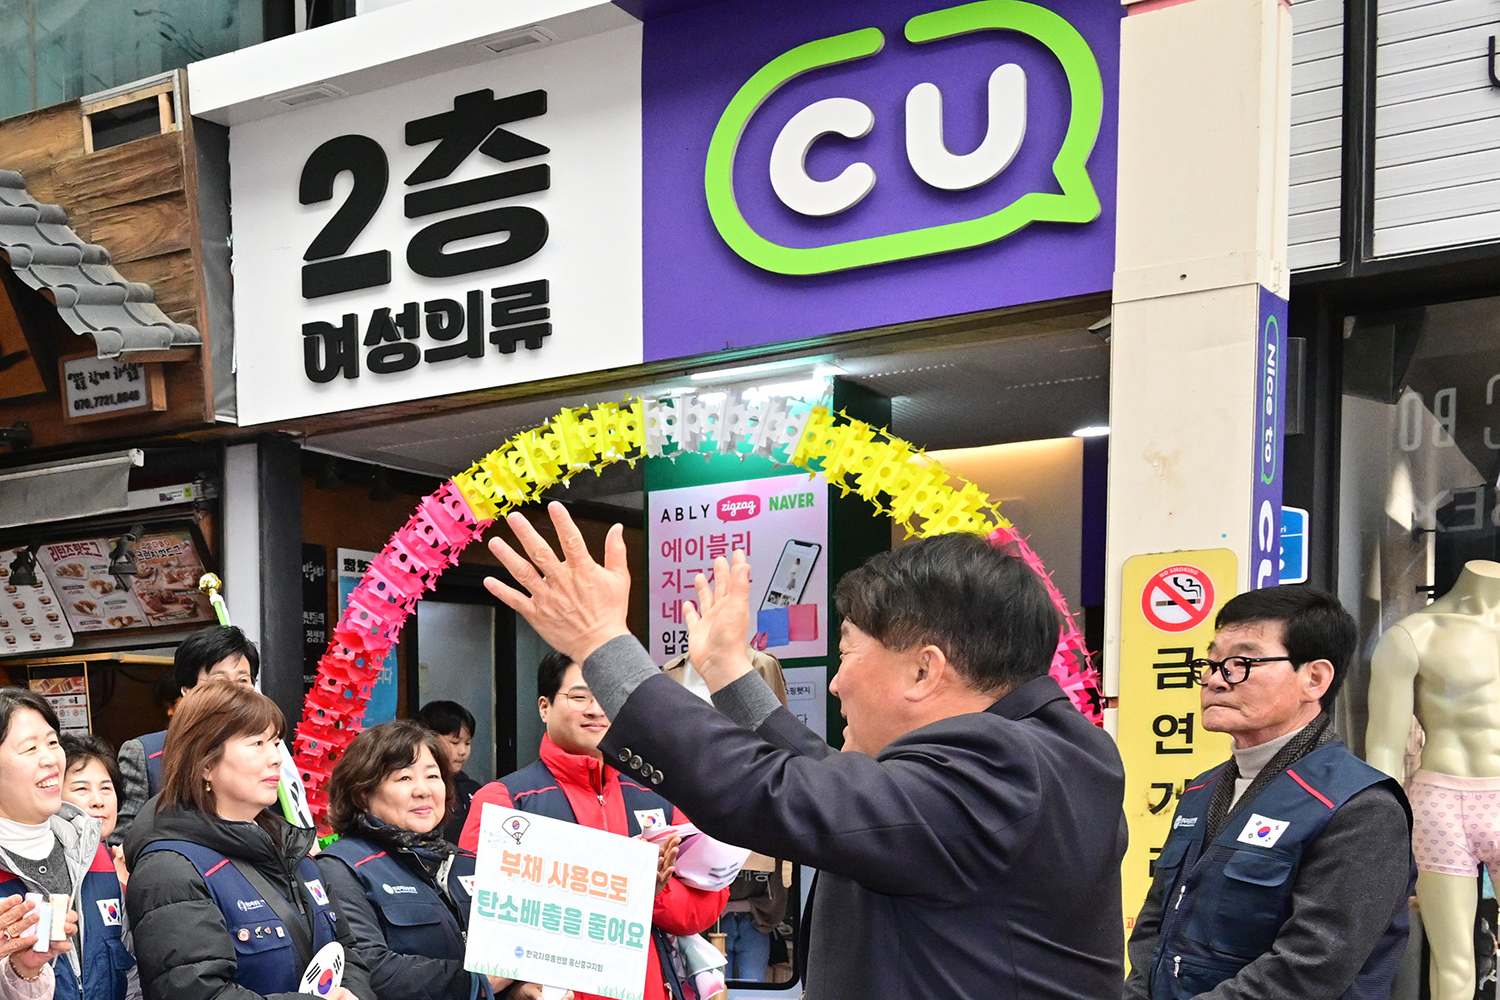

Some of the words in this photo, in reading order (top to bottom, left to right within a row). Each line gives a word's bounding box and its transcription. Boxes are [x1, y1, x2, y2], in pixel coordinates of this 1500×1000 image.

[768, 62, 1028, 217] CU
[299, 89, 552, 299] 2층
[301, 279, 553, 384] 여성의류
[1266, 343, 1277, 416] Nice
[1264, 426, 1274, 463] to
[660, 503, 710, 524] ABLY
[721, 499, 757, 516] zigzag
[768, 492, 816, 512] NAVER
[661, 531, 752, 563] 에이블리
[1159, 568, 1170, 578] NO
[1168, 565, 1199, 576] SMOKING
[499, 849, 543, 884] 부채
[547, 860, 629, 903] 사용으로
[476, 888, 583, 937] 탄소배출을
[587, 911, 645, 950] 줄여요
